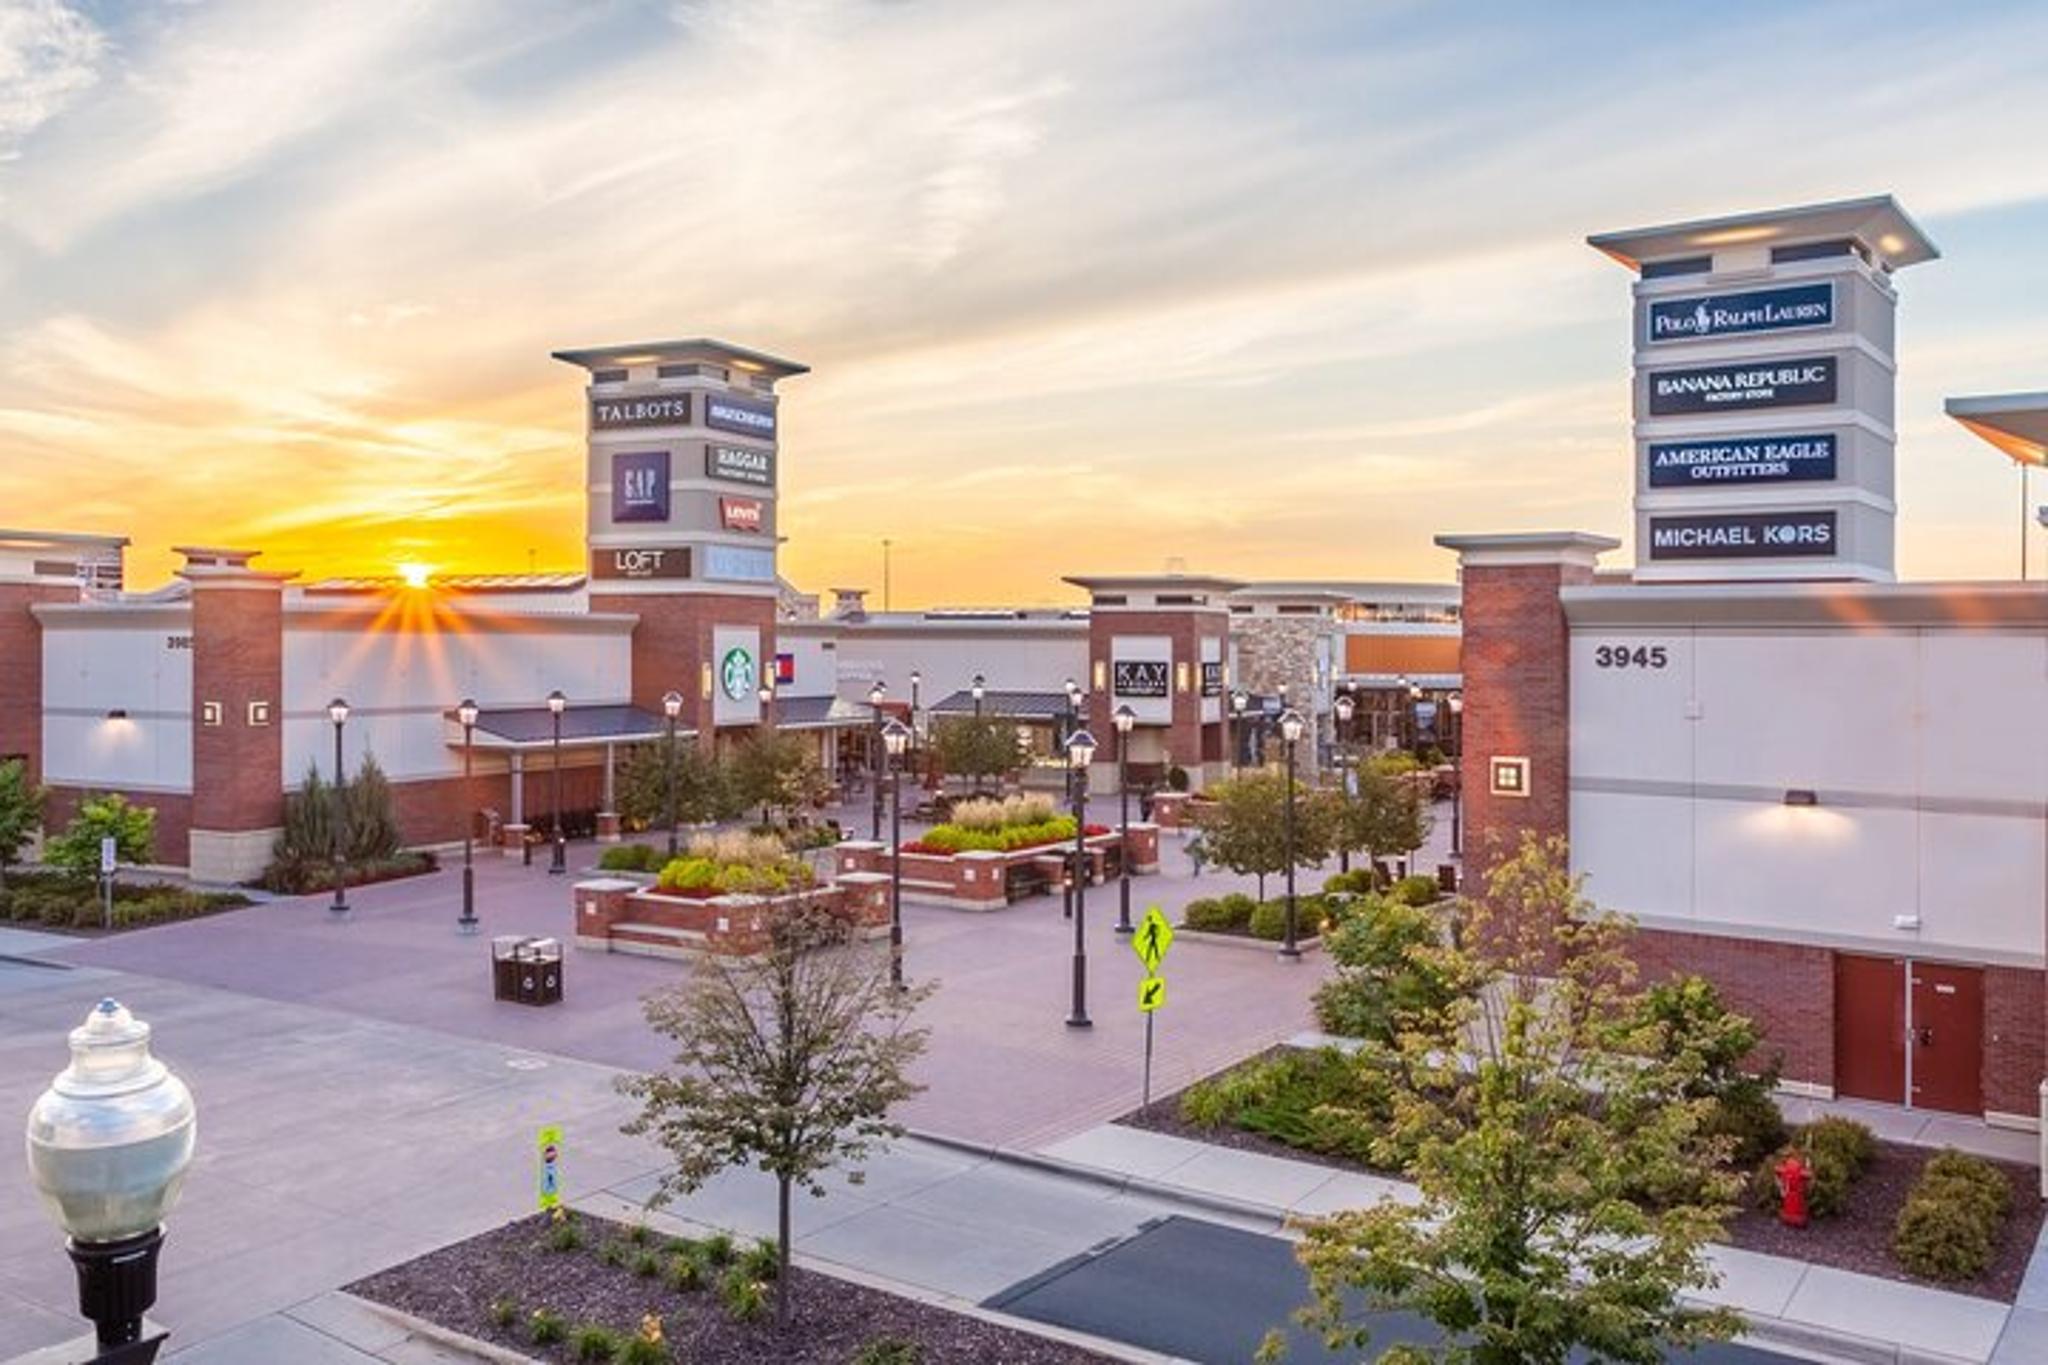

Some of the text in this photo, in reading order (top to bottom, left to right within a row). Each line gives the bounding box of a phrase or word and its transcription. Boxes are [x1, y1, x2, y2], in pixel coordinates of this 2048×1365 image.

[1654, 303, 1827, 334] POLO RALPH LAUREN
[1657, 366, 1827, 396] BANANA REPUBLIC
[597, 400, 684, 421] TALBOTS
[1655, 442, 1829, 467] AMERICAN EAGLE
[1690, 461, 1790, 479] OUTFITTERS
[624, 469, 656, 498] GAP
[1654, 524, 1831, 547] MICHAEL KORS
[616, 551, 665, 570] LOFT
[1595, 645, 1668, 669] 3945
[1117, 664, 1165, 681] KAY
